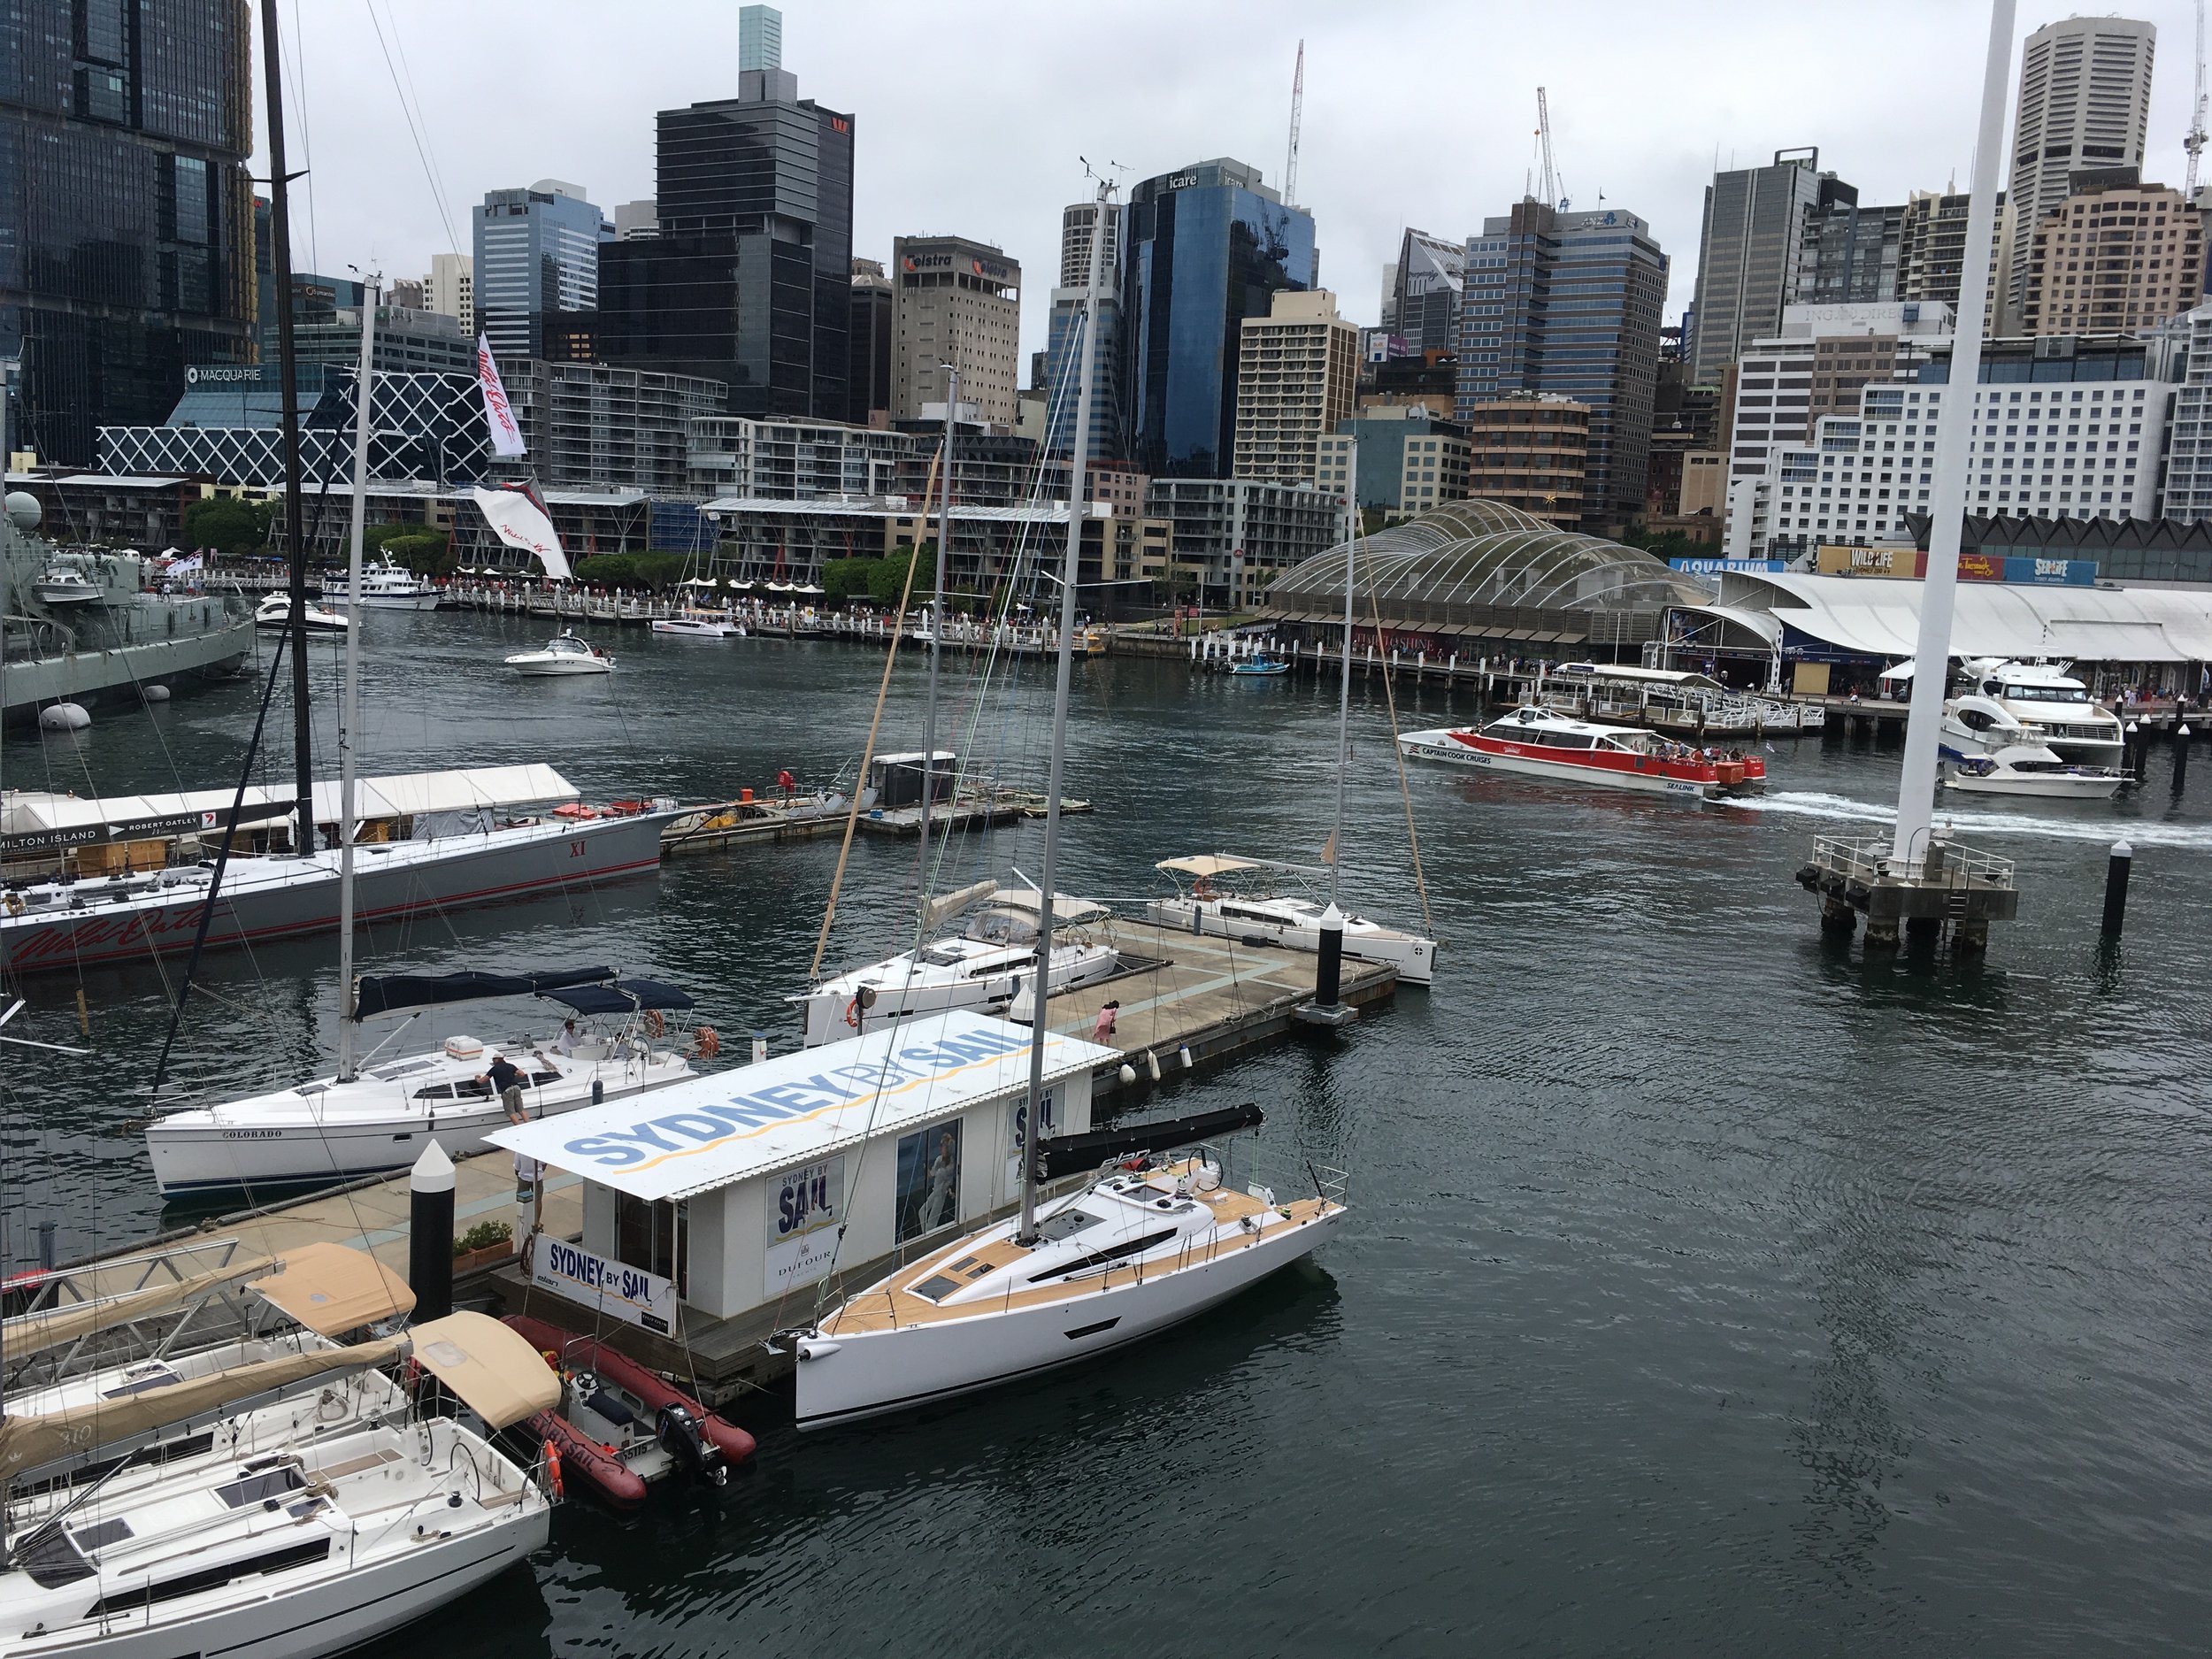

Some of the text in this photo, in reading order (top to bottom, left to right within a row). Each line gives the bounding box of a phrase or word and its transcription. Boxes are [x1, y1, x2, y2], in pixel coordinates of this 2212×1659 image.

[1169, 175, 1197, 189] icare
[904, 254, 951, 271] Telstra
[200, 368, 261, 382] MACQUARIE
[1680, 560, 1769, 574] AQUARIUM
[1851, 549, 1893, 568] WILD LIFE
[1400, 636, 1434, 652] SHINE
[1422, 747, 1447, 757] CAPTAIN
[1466, 754, 1491, 764] CRUISES
[1666, 782, 1695, 792] SEALINK
[129, 818, 196, 831] ROBERT OATLEY
[50, 830, 96, 843] ISLAND
[570, 841, 586, 857] XI
[564, 1029, 1033, 1165] SYDNEY BY SAIL
[1018, 1088, 1053, 1107] SYY BY
[1015, 1098, 1056, 1148] SIL
[222, 1130, 282, 1139] COLORADO
[1101, 1149, 1149, 1168] elan
[782, 1164, 828, 1187] SYDNEY BY
[779, 1175, 832, 1233] SAIL
[779, 1251, 832, 1276] DUFOUR
[537, 1275, 558, 1287] elan
[550, 1243, 653, 1307] SYDNEY BY SAIL
[566, 1443, 595, 1472] SAIL
